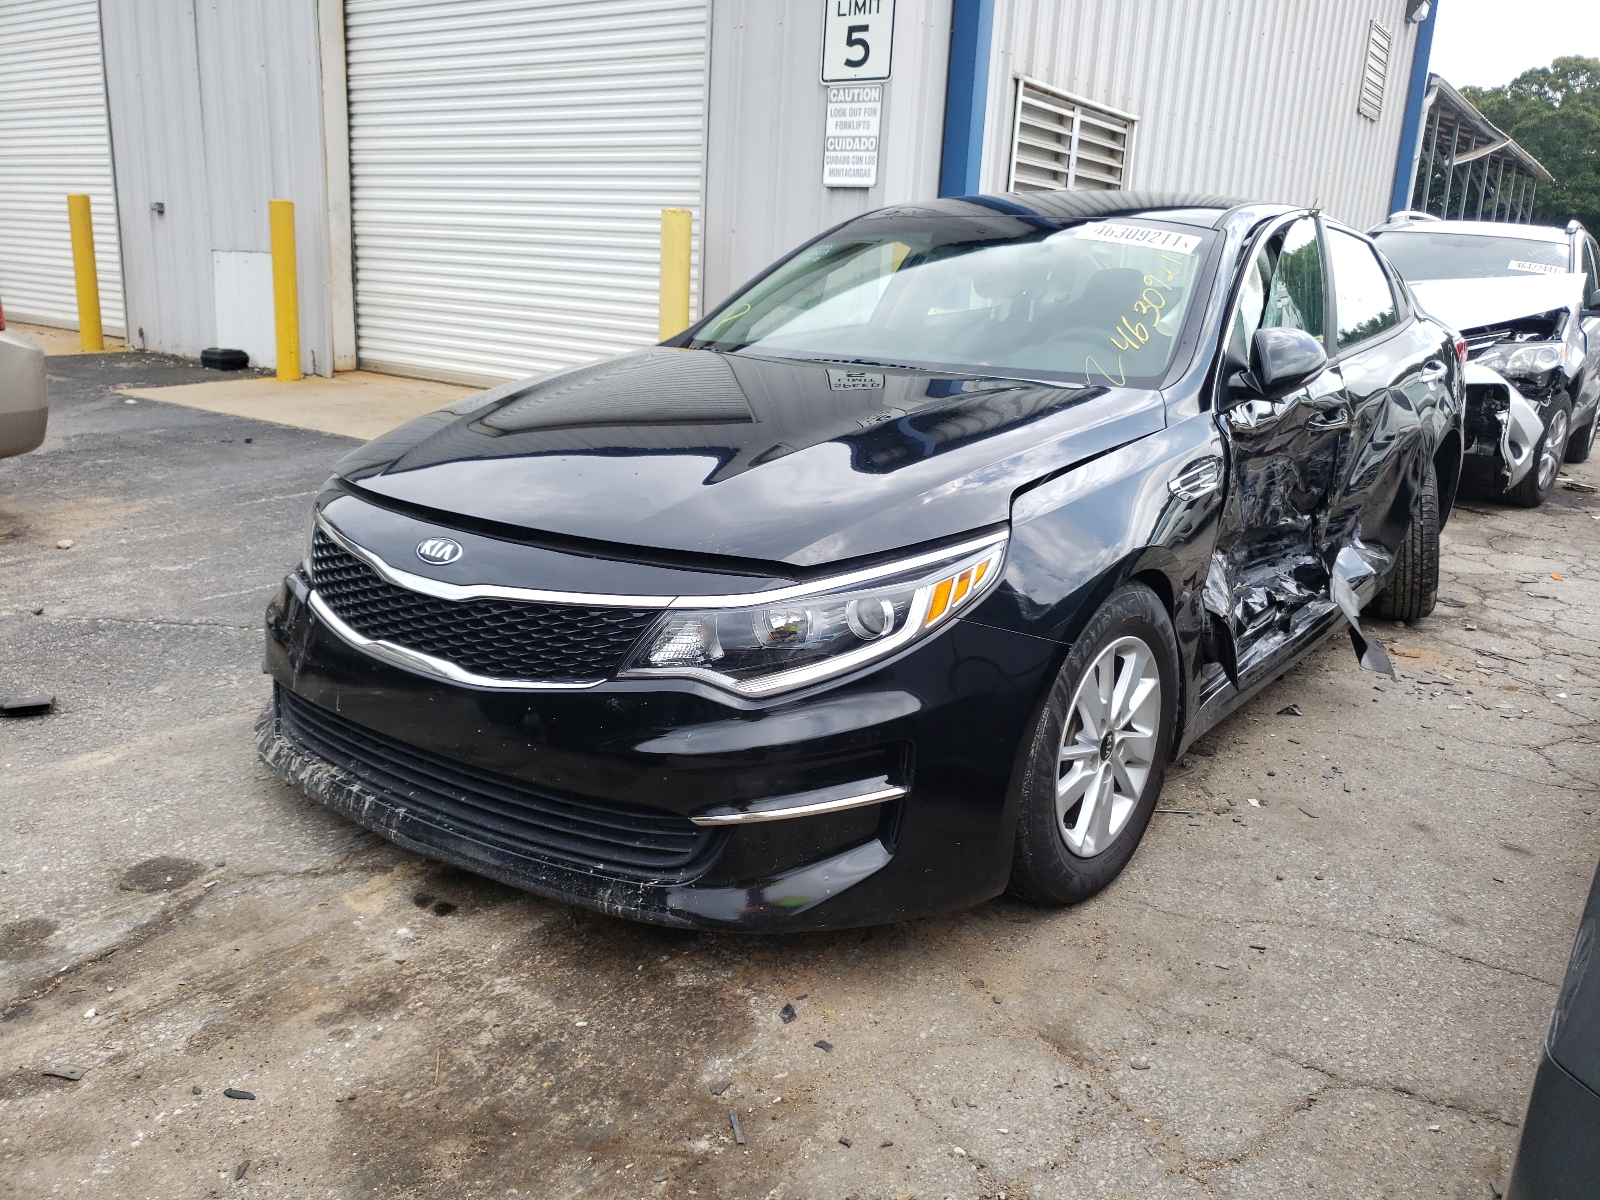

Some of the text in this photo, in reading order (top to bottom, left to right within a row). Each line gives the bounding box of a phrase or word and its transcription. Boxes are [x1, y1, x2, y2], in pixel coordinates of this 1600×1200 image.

[837, 0, 882, 17] LIMIT
[844, 24, 870, 68] 5
[829, 88, 880, 103] CAUTION
[830, 107, 878, 118] LOOK OUT FOR
[834, 120, 871, 131] FORKLIFTS
[826, 137, 876, 151] CUIDADO
[825, 155, 876, 166] CUIDADO CON LOS
[828, 168, 872, 179] MONTACARGAS
[420, 539, 454, 561] KIA
[1104, 734, 1112, 759] KIA
